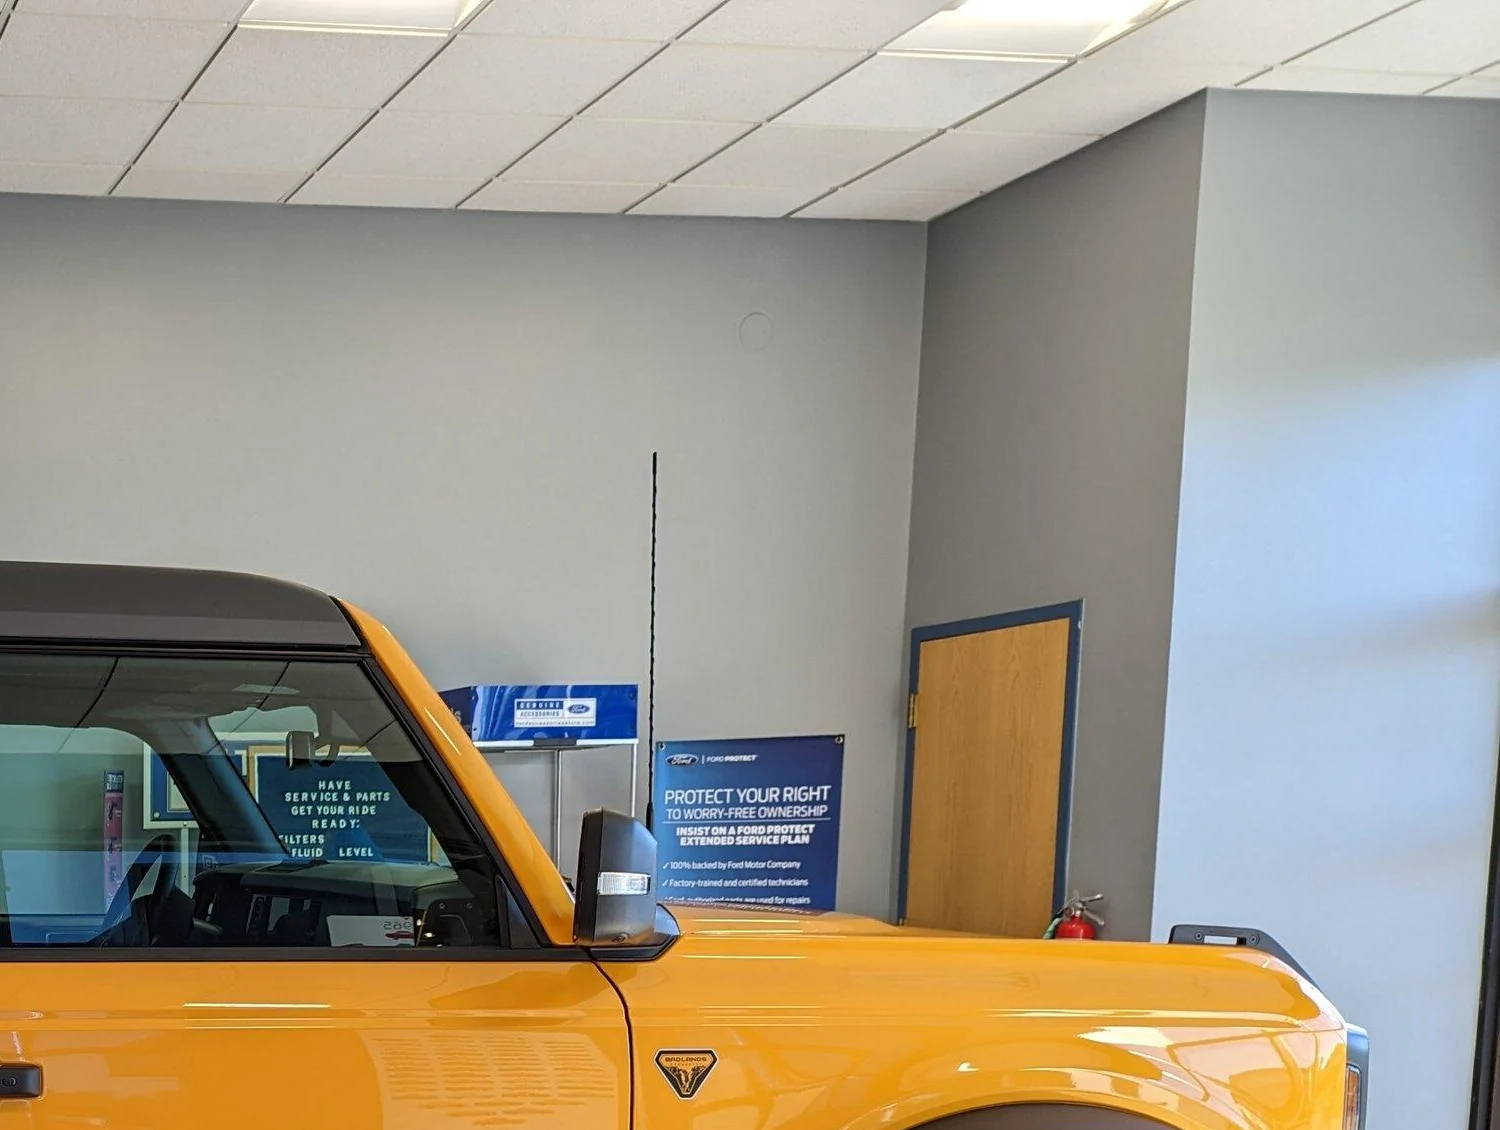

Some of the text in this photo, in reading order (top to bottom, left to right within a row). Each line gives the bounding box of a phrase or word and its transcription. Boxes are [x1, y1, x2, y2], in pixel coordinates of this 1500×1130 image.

[569, 704, 589, 713] Ford
[668, 754, 696, 765] Ford
[318, 780, 351, 790] HAVE
[284, 791, 390, 802] SERVICE & PARTS
[665, 785, 832, 804] PROTECT YOUR RIGHT
[291, 805, 377, 815] GET YOUR RIDE
[667, 805, 828, 820] TO WORRY-FREE OWNERSHIP
[312, 819, 360, 829] READY:
[676, 824, 816, 836] INSIST ON A FORD PROTECT
[680, 834, 810, 846] EXTENDED SERVICE PLAN
[291, 847, 374, 857] FLUID LEVEL
[691, 861, 717, 869] backed
[718, 862, 727, 871] by
[727, 861, 744, 869] Ford
[744, 860, 766, 869] Motor
[766, 860, 801, 870] Company
[669, 878, 808, 888] Factory-trained and certified technicians
[757, 896, 774, 904] used
[774, 896, 785, 904] for
[785, 896, 811, 905] repairs
